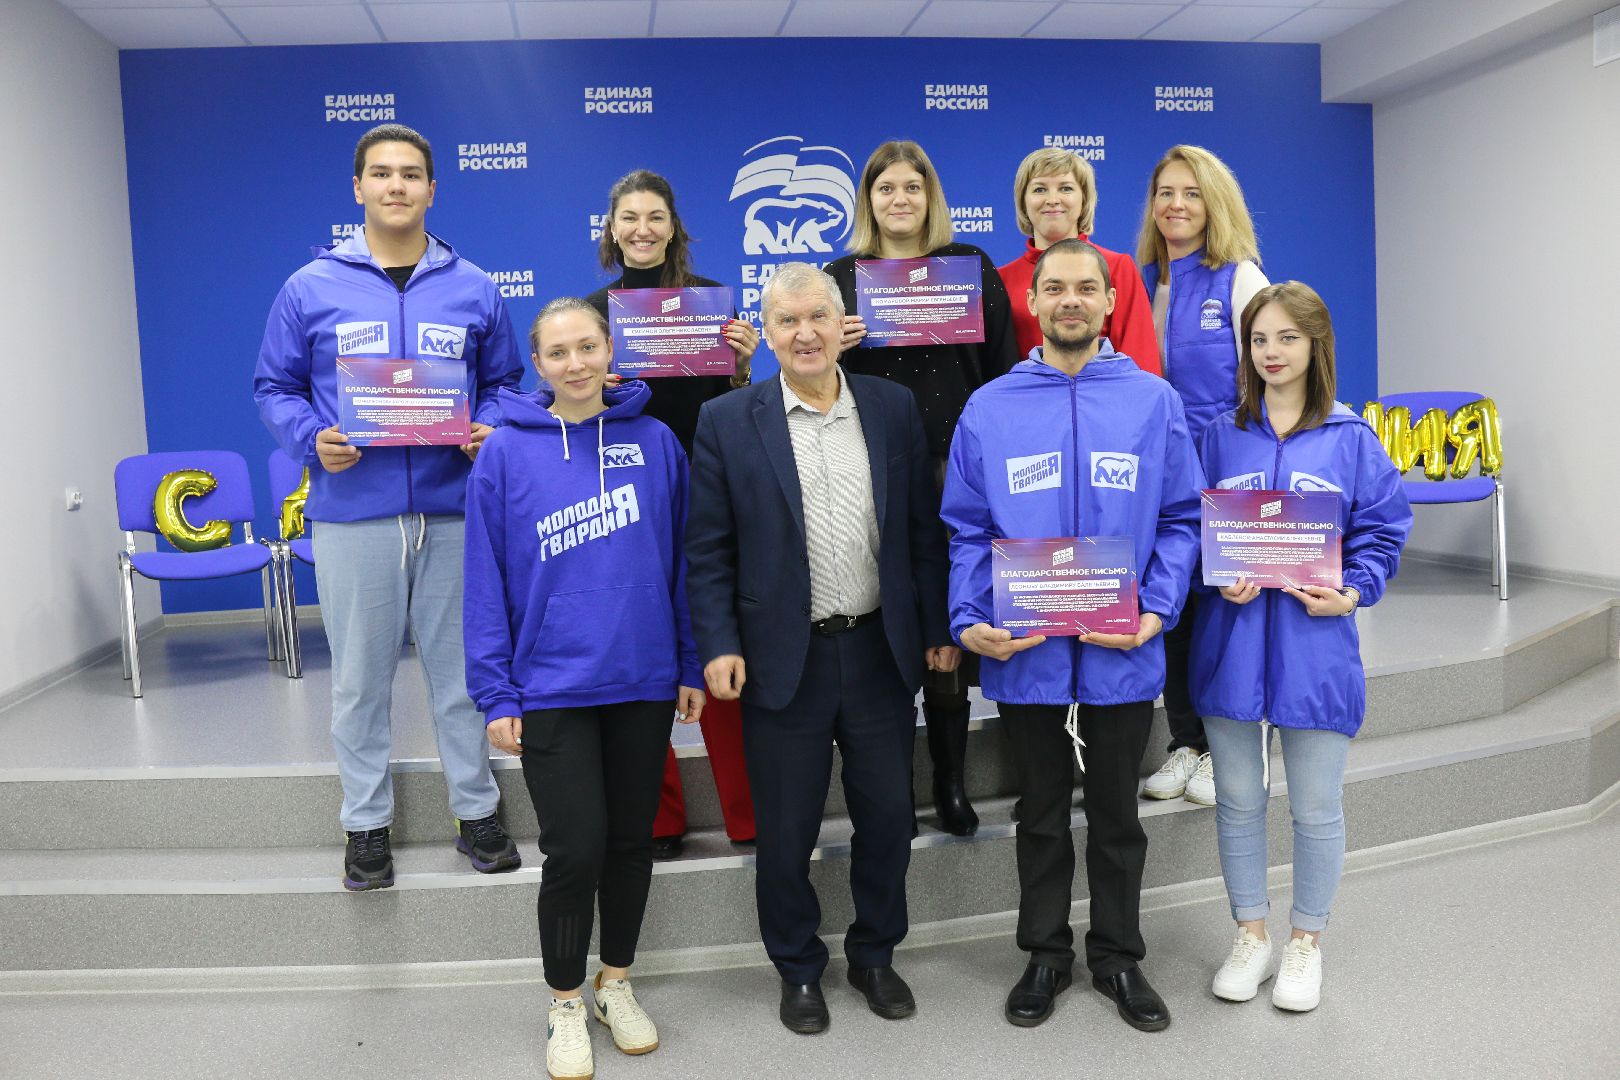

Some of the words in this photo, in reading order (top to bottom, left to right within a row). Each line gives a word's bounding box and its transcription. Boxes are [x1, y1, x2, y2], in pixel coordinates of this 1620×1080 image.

[585, 87, 652, 101] ЕДИНАЯ
[925, 85, 988, 97] ЕДИНАЯ
[1155, 86, 1213, 99] ЕДИНАЯ
[325, 94, 394, 108] ЕДИНАЯ
[585, 100, 652, 113] РОССИЯ
[926, 97, 988, 109] РОССИЯ
[1155, 99, 1213, 111] РОССИЯ
[326, 108, 395, 122] РОССИЯ
[1043, 135, 1104, 148] ЕДИНАЯ
[458, 142, 527, 157] ЕДИНАЯ
[458, 156, 527, 170] РОССИЯ
[950, 207, 992, 218] ИНАЯ
[952, 220, 993, 232] ССИЯ
[487, 270, 533, 283] ИНАЯ
[499, 284, 534, 297] СИЯ
[864, 285, 942, 294] БЛАГОДАРСТВЕННОЕ
[616, 315, 694, 324] БЛАГОДАРСТВЕННОЕ
[340, 323, 384, 343] МОЛОДАЯ
[345, 386, 426, 395] БЛАГОДАРСТВЕННОЕ
[1012, 454, 1059, 481] МОЛОДАЯ
[536, 483, 640, 540] МОЛОДАЯ
[1209, 520, 1296, 529] БЛАГОДАРСТВЕННОЕ
[1000, 568, 1090, 578] БЛАГОДАРСТВЕННОЕ
[1091, 567, 1128, 575] ПИСЬМО
